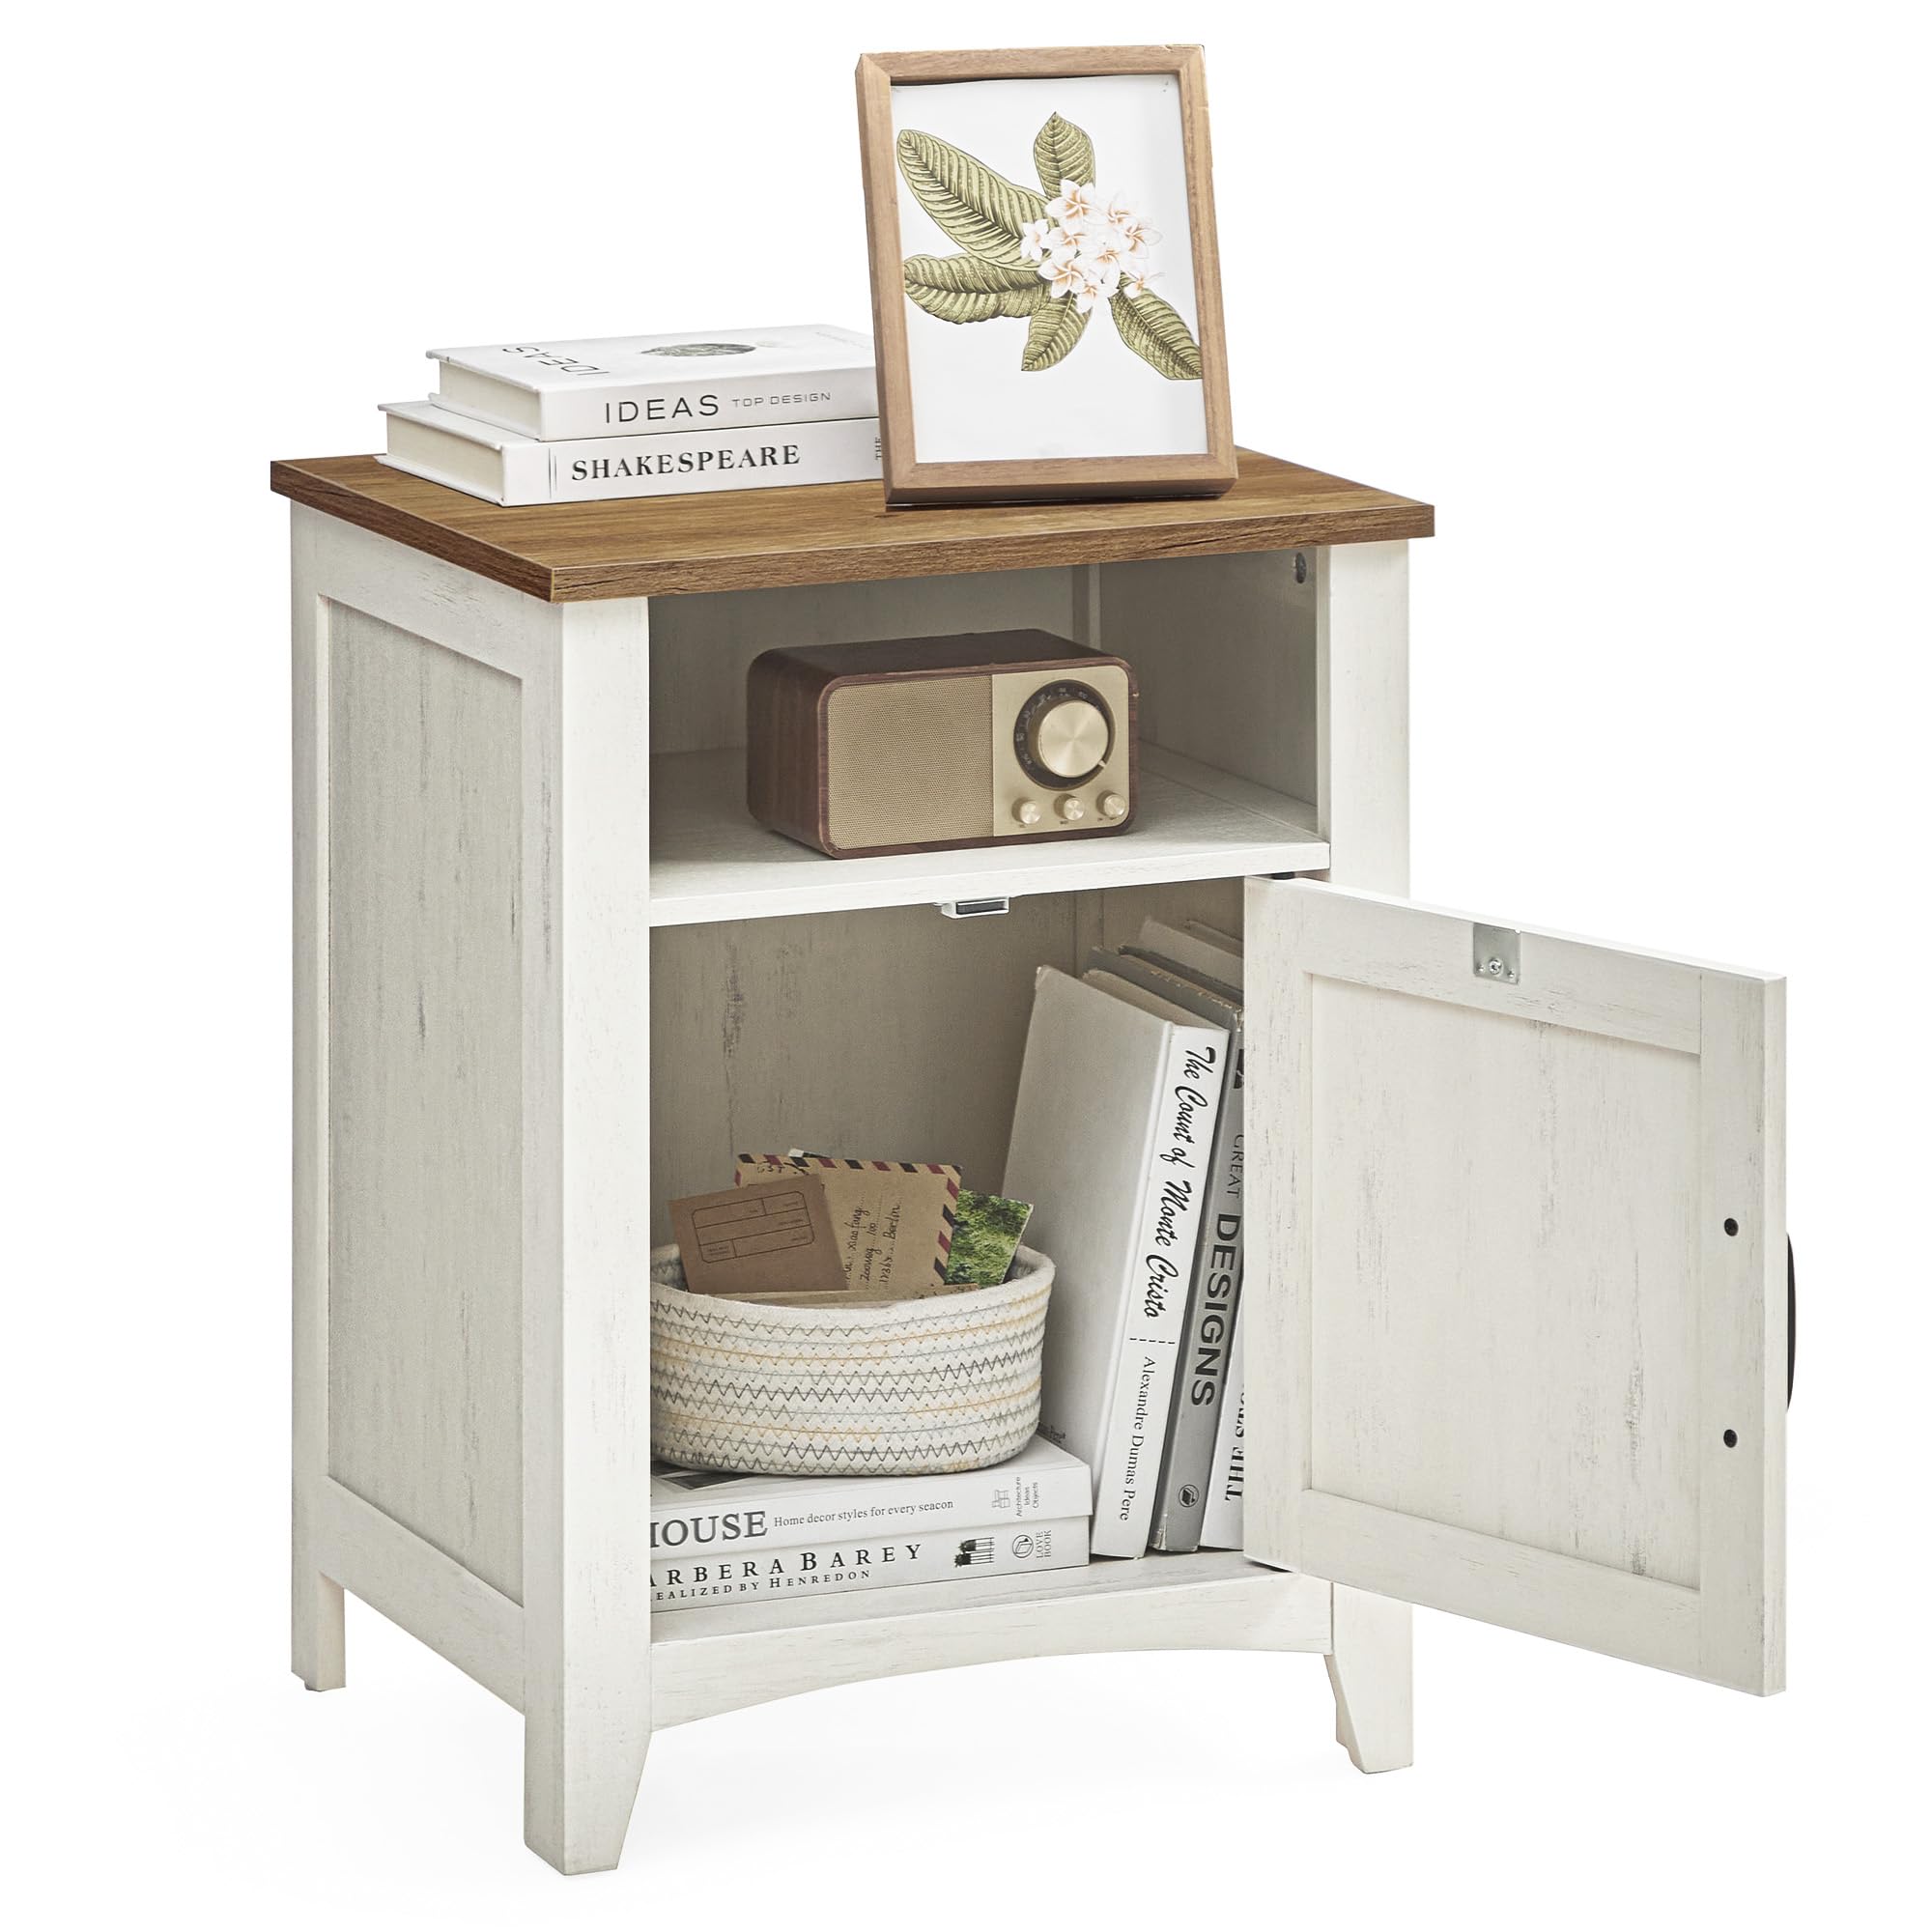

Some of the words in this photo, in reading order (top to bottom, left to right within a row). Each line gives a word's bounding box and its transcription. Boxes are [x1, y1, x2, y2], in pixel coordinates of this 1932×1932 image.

[501, 346, 611, 376] IDEAS
[605, 394, 720, 424] IDEAS
[732, 397, 764, 408] TOP
[770, 392, 832, 406] DESIGN
[572, 443, 801, 481] SHAKESPEARE
[1184, 1046, 1216, 1080] The
[1174, 1085, 1208, 1145] Count
[1159, 1147, 1196, 1169] of
[1226, 1134, 1244, 1198] GREAT
[1154, 1179, 1192, 1247] Monte
[1144, 1254, 1179, 1319] Cristo
[1191, 1213, 1242, 1406] DESIGNS
[1133, 1355, 1156, 1431] Alexandre
[1124, 1435, 1145, 1486] Dumas
[774, 1516, 805, 1527] Home
[807, 1513, 837, 1524] decor
[838, 1508, 868, 1522] styles
[870, 1505, 886, 1517] for
[888, 1503, 917, 1516] every
[1119, 1489, 1136, 1521] Pere
[800, 1544, 922, 1572] BAREY
[1036, 1530, 1044, 1559] LOVE
[1043, 1529, 1052, 1558] BOOK
[650, 1584, 732, 1602] EALIZED
[739, 1580, 760, 1593] BY
[769, 1570, 871, 1589] HENREDON
